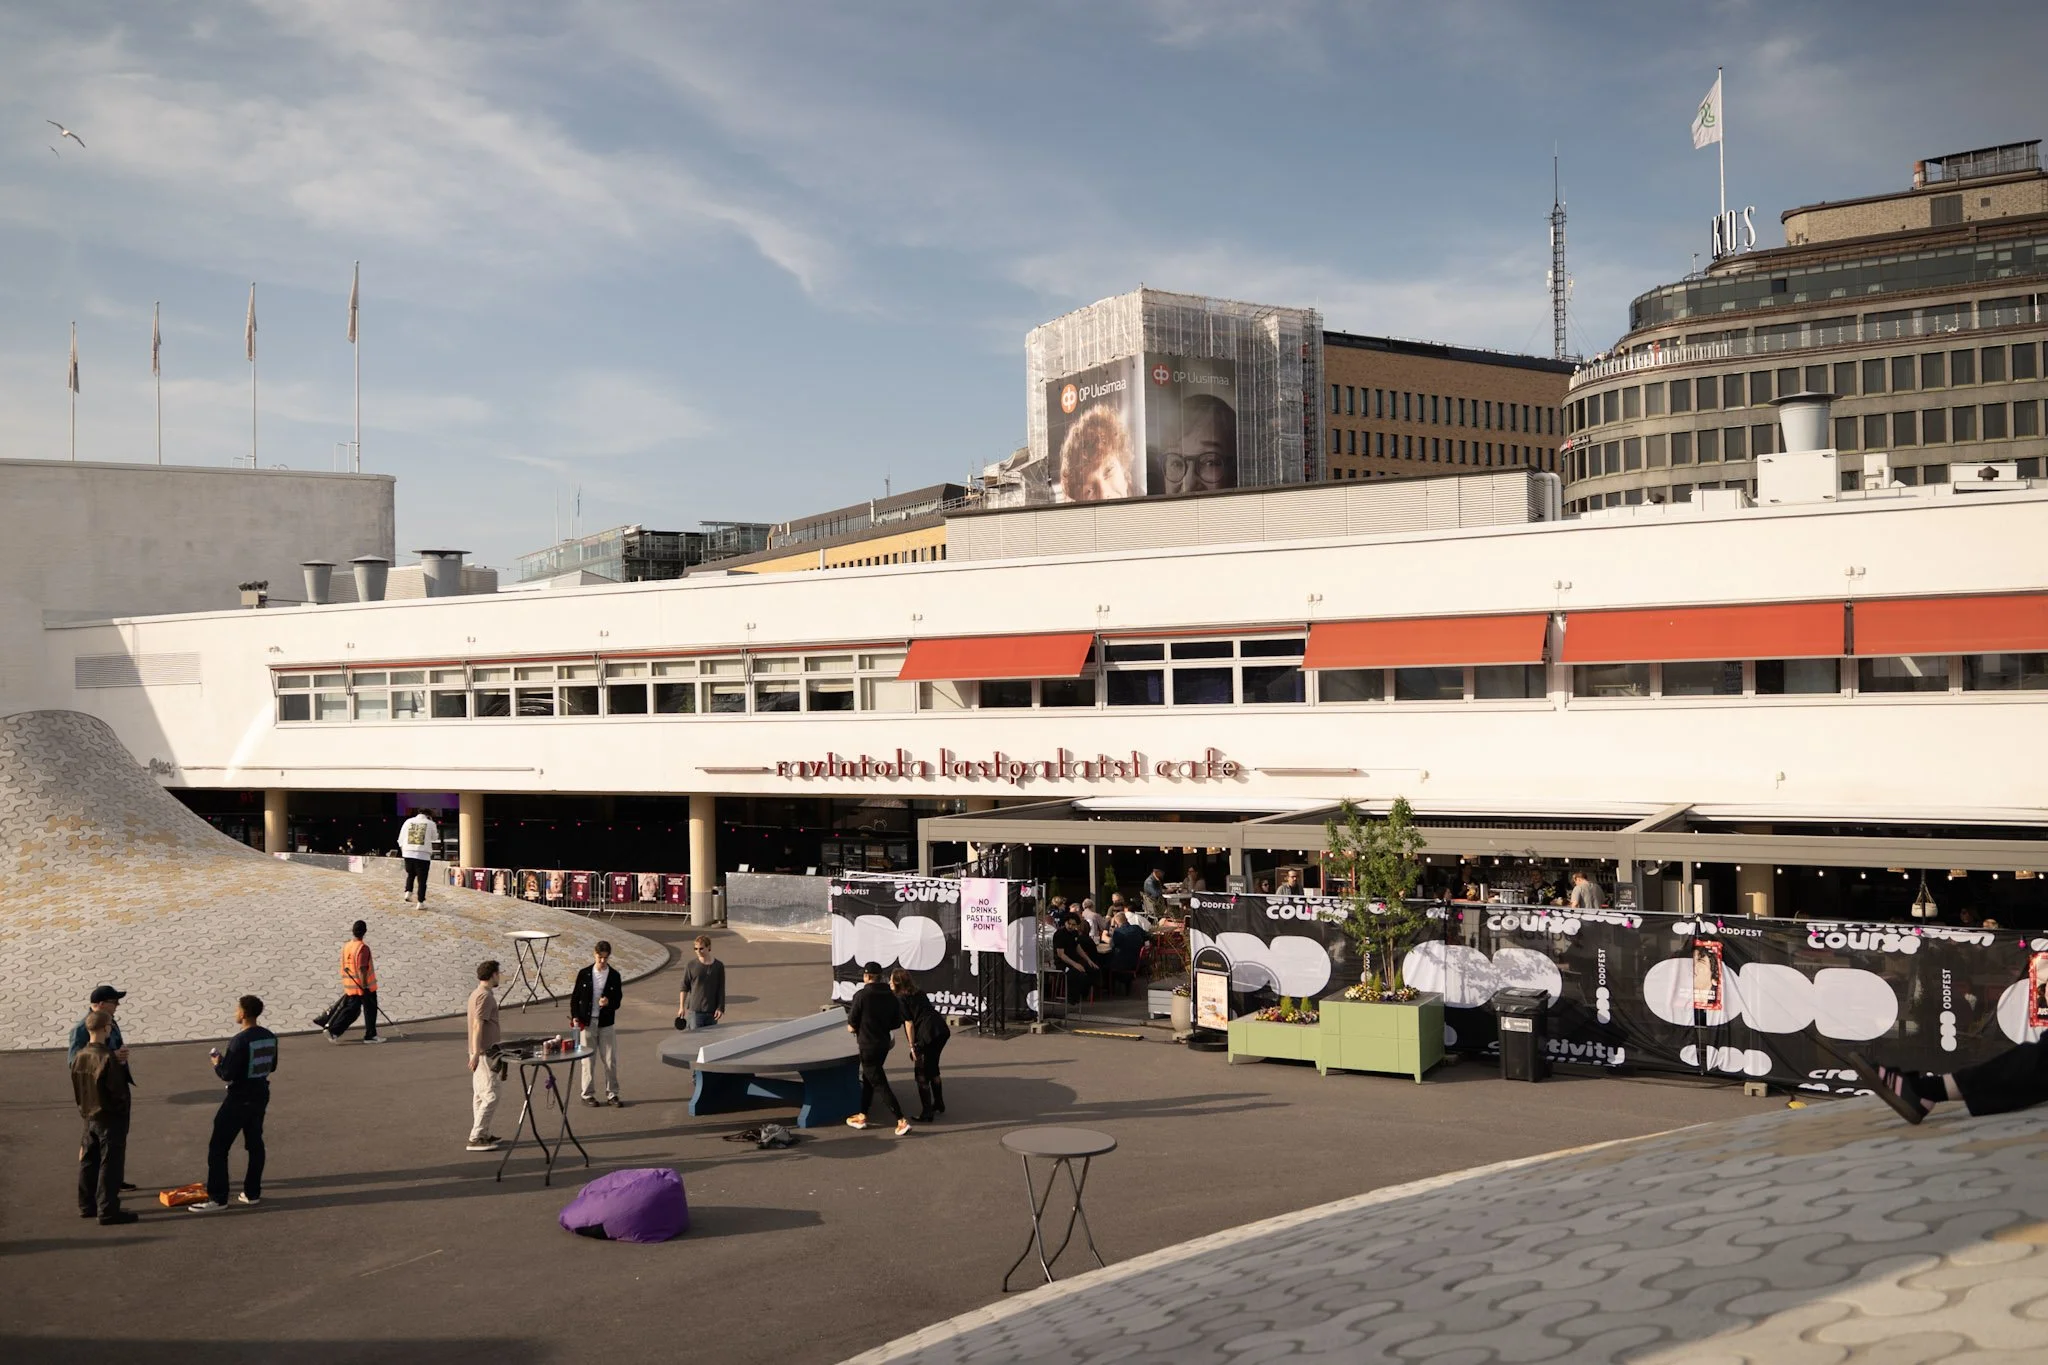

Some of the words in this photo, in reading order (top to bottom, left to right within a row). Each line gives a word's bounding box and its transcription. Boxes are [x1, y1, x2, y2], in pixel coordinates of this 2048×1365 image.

[1712, 206, 1756, 256] KOS
[1173, 372, 1185, 383] OP
[1188, 372, 1229, 386] Uusimaa
[1079, 386, 1091, 402] OP
[1092, 378, 1127, 398] Uusimaa
[895, 887, 960, 904] course
[978, 898, 990, 906] NO
[970, 906, 998, 914] DRINKS
[1201, 902, 1235, 910] ODDFEST
[966, 914, 984, 922] PAST
[986, 915, 1002, 923] THIS
[973, 923, 996, 931] POINT
[1719, 927, 1763, 937] ODDFEST
[1807, 932, 1921, 955] course
[1598, 948, 1606, 986] ODDFEST
[1942, 968, 1952, 1010] ODDFEST
